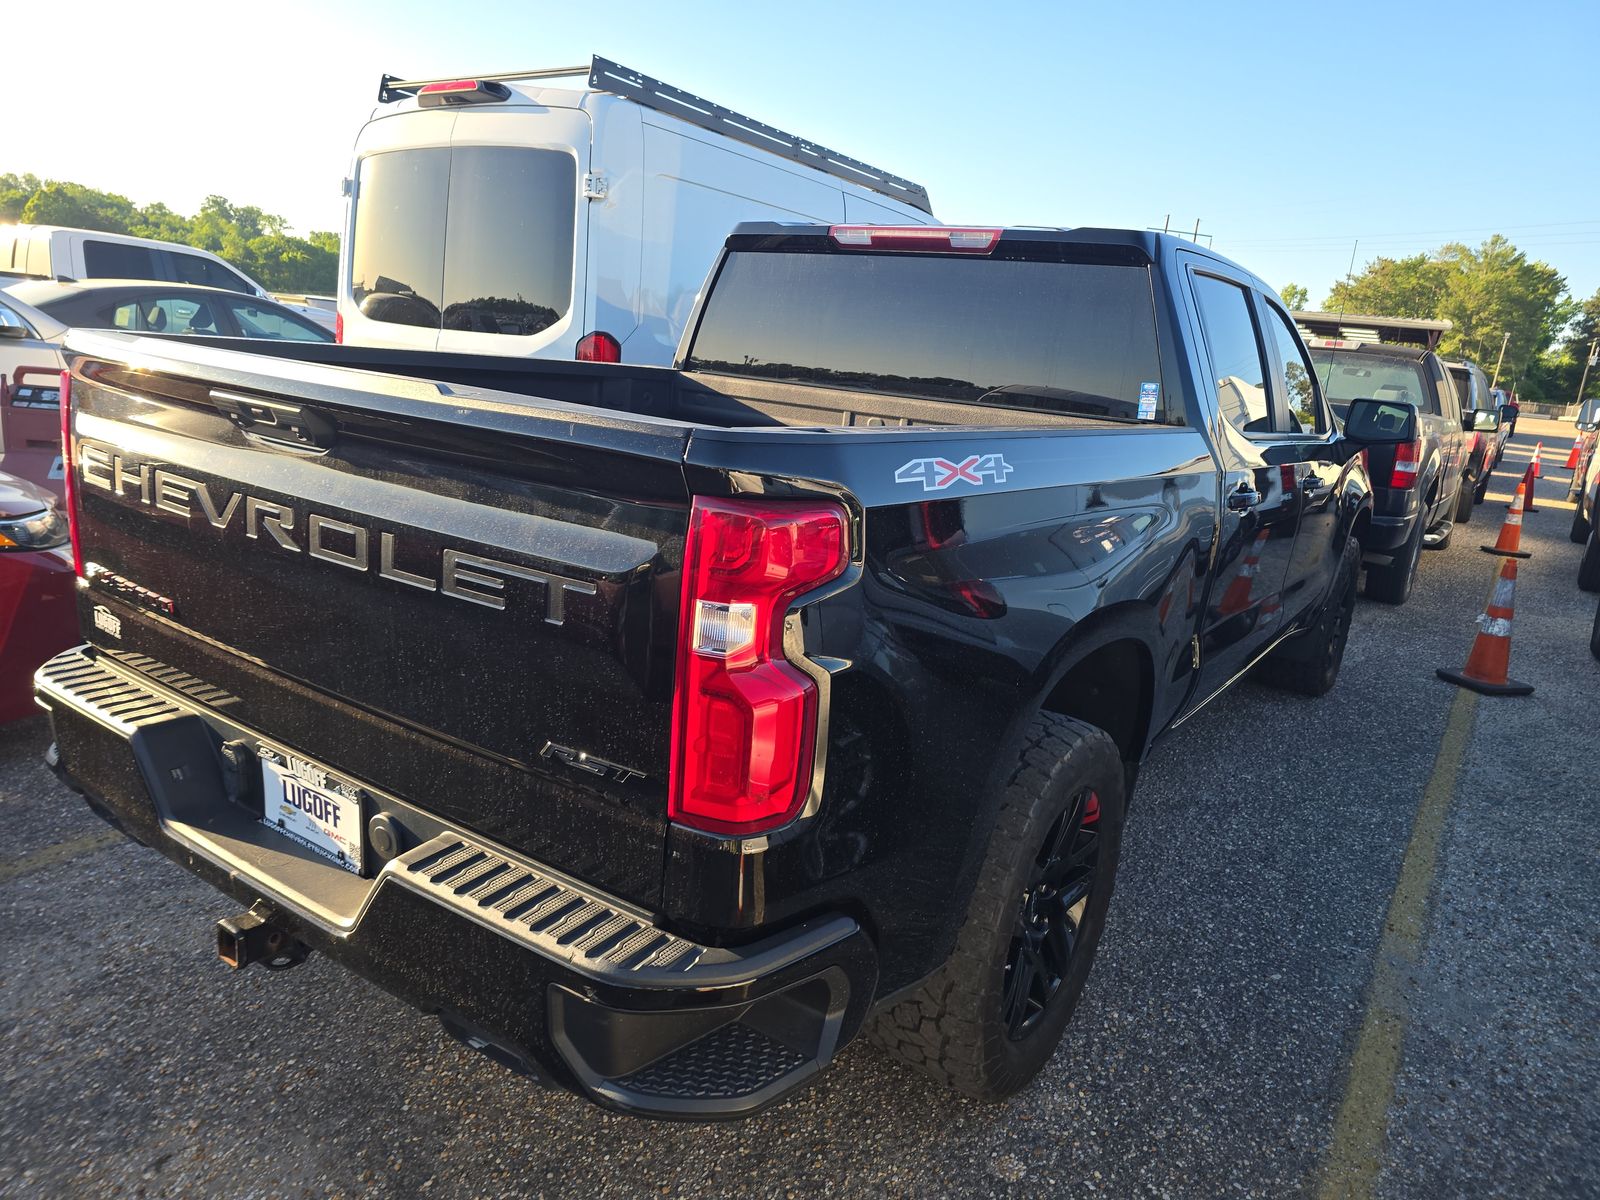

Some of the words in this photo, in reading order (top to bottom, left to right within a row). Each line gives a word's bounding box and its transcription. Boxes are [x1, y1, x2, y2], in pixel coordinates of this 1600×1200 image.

[81, 444, 597, 625] CHEVROLET
[286, 754, 328, 789] LUGOFF
[540, 741, 647, 783] RST
[282, 778, 341, 828] LUGOFF
